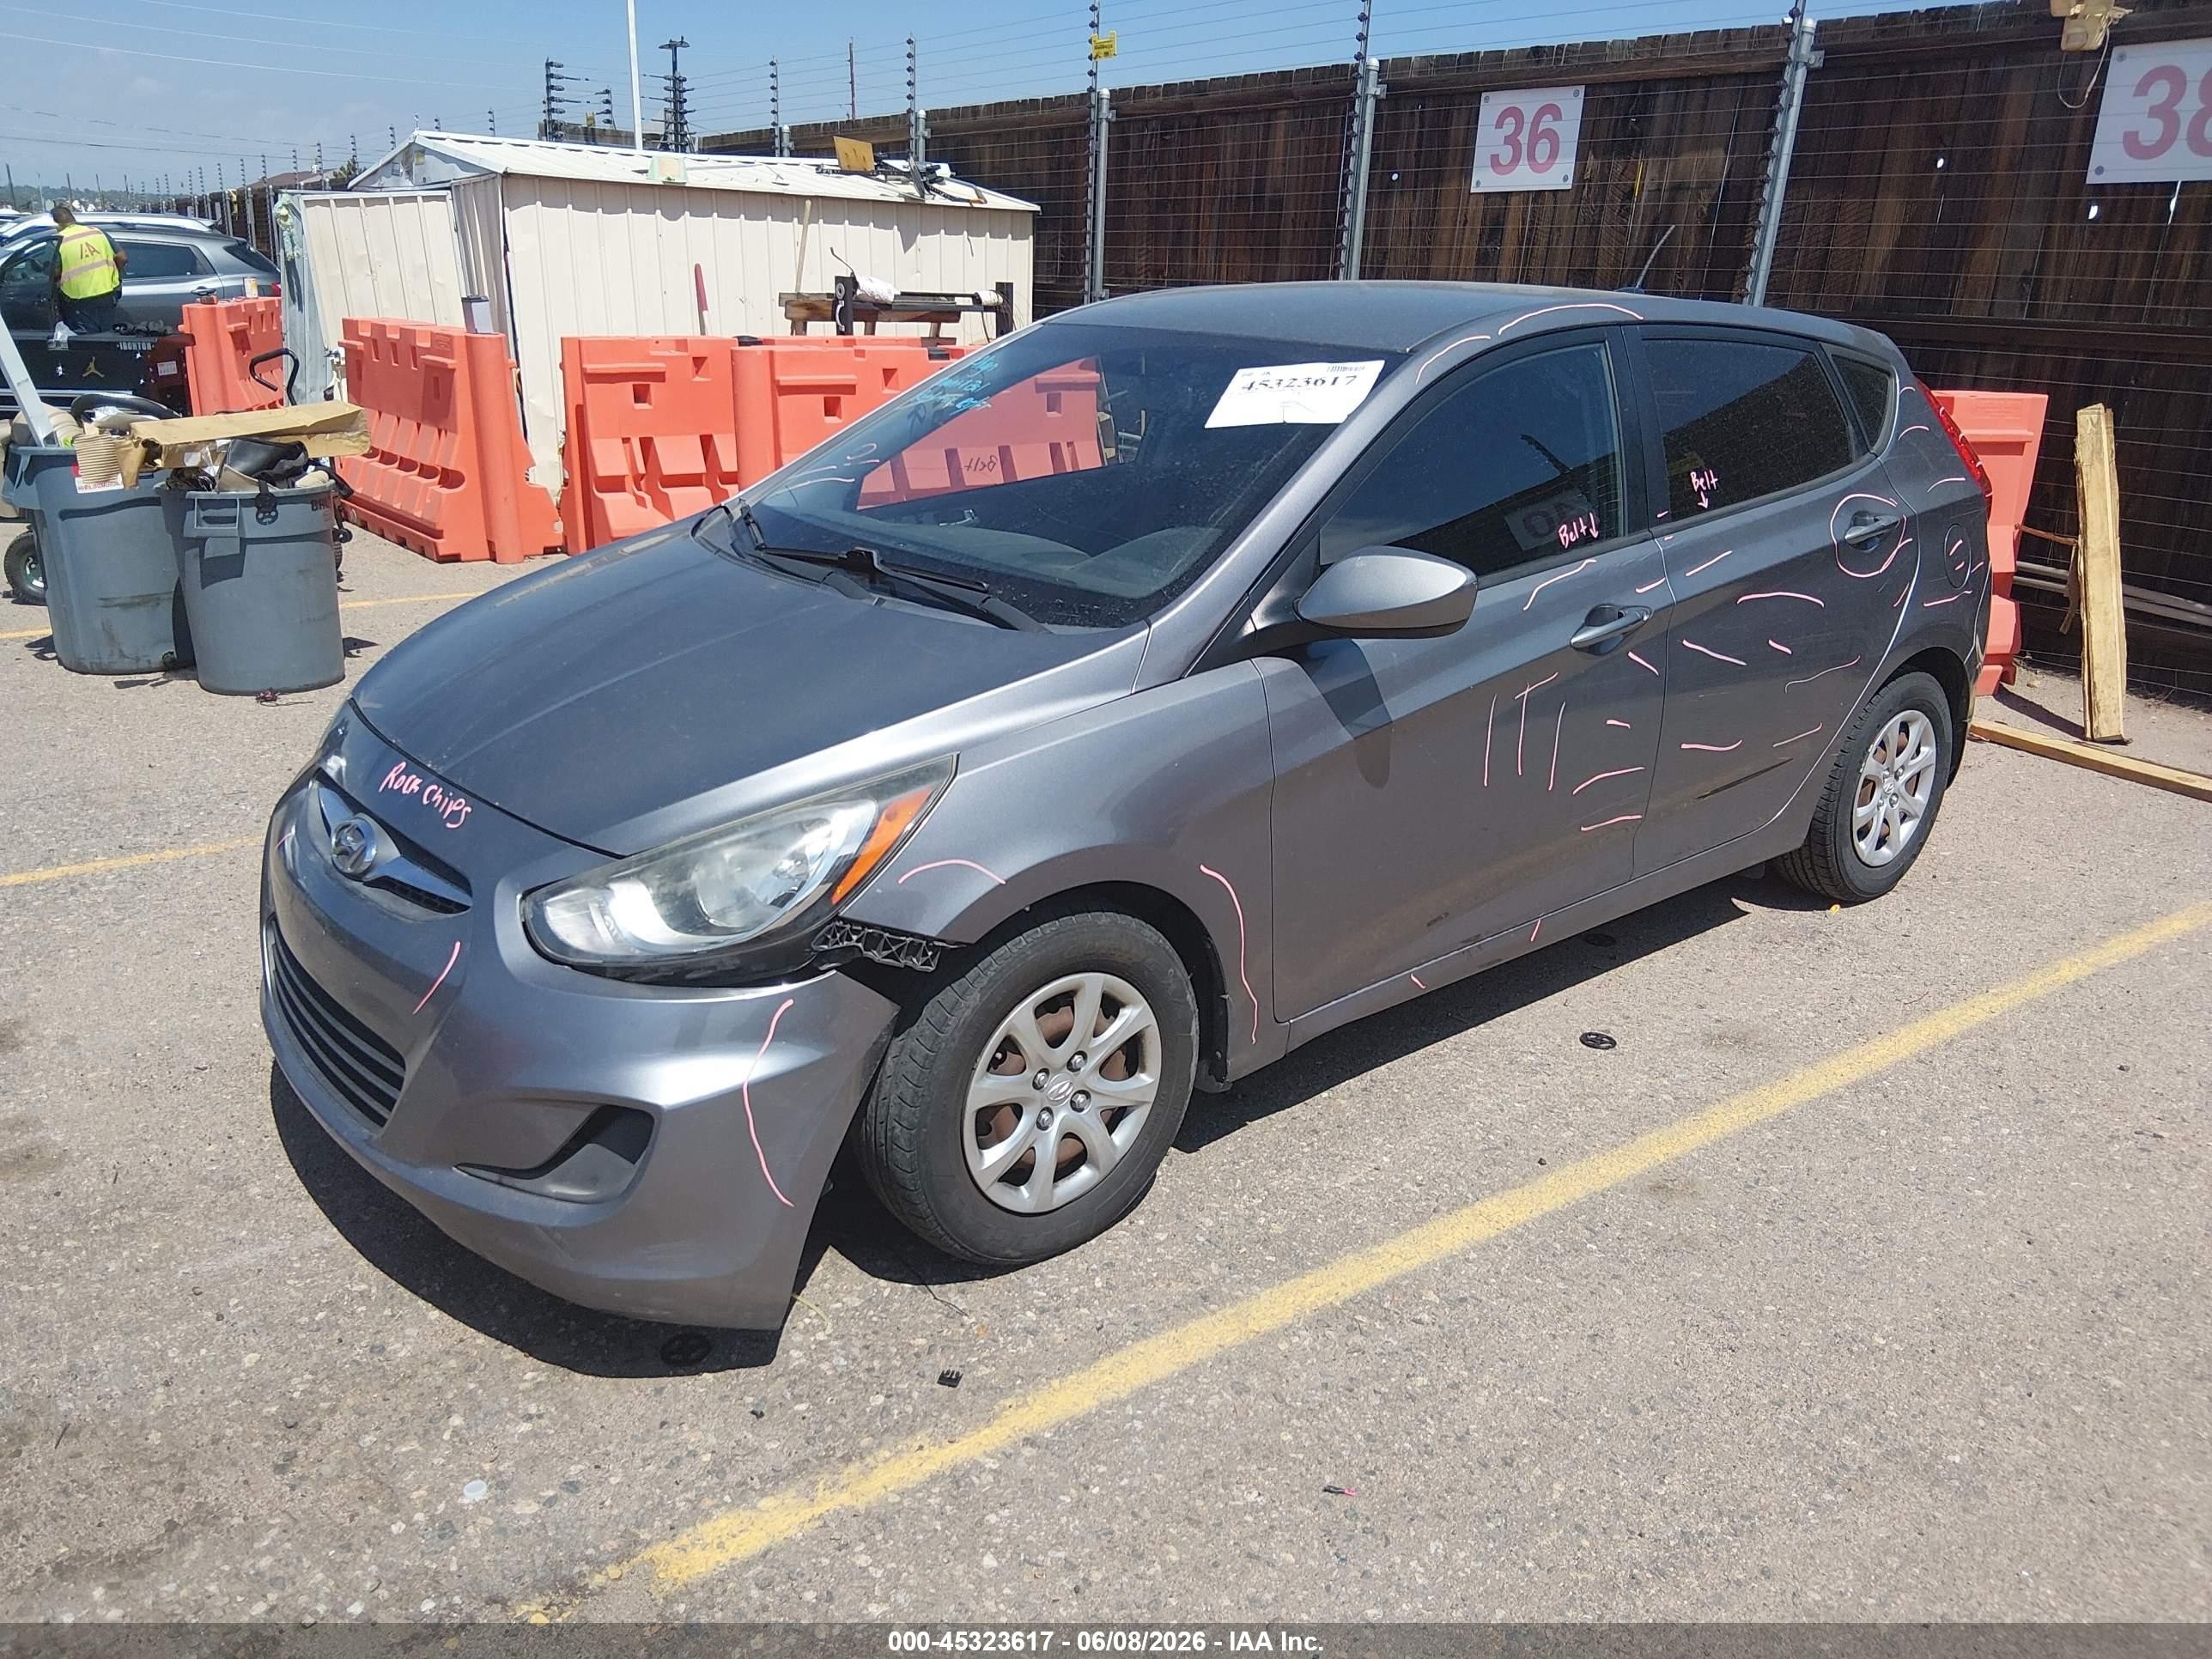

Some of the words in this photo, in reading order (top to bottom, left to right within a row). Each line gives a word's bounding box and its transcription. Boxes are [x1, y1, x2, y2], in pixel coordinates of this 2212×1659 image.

[1490, 103, 1563, 176] 36
[1242, 374, 1358, 391] 45323617
[1690, 469, 1718, 492] Belt
[1558, 516, 1588, 550] Belt
